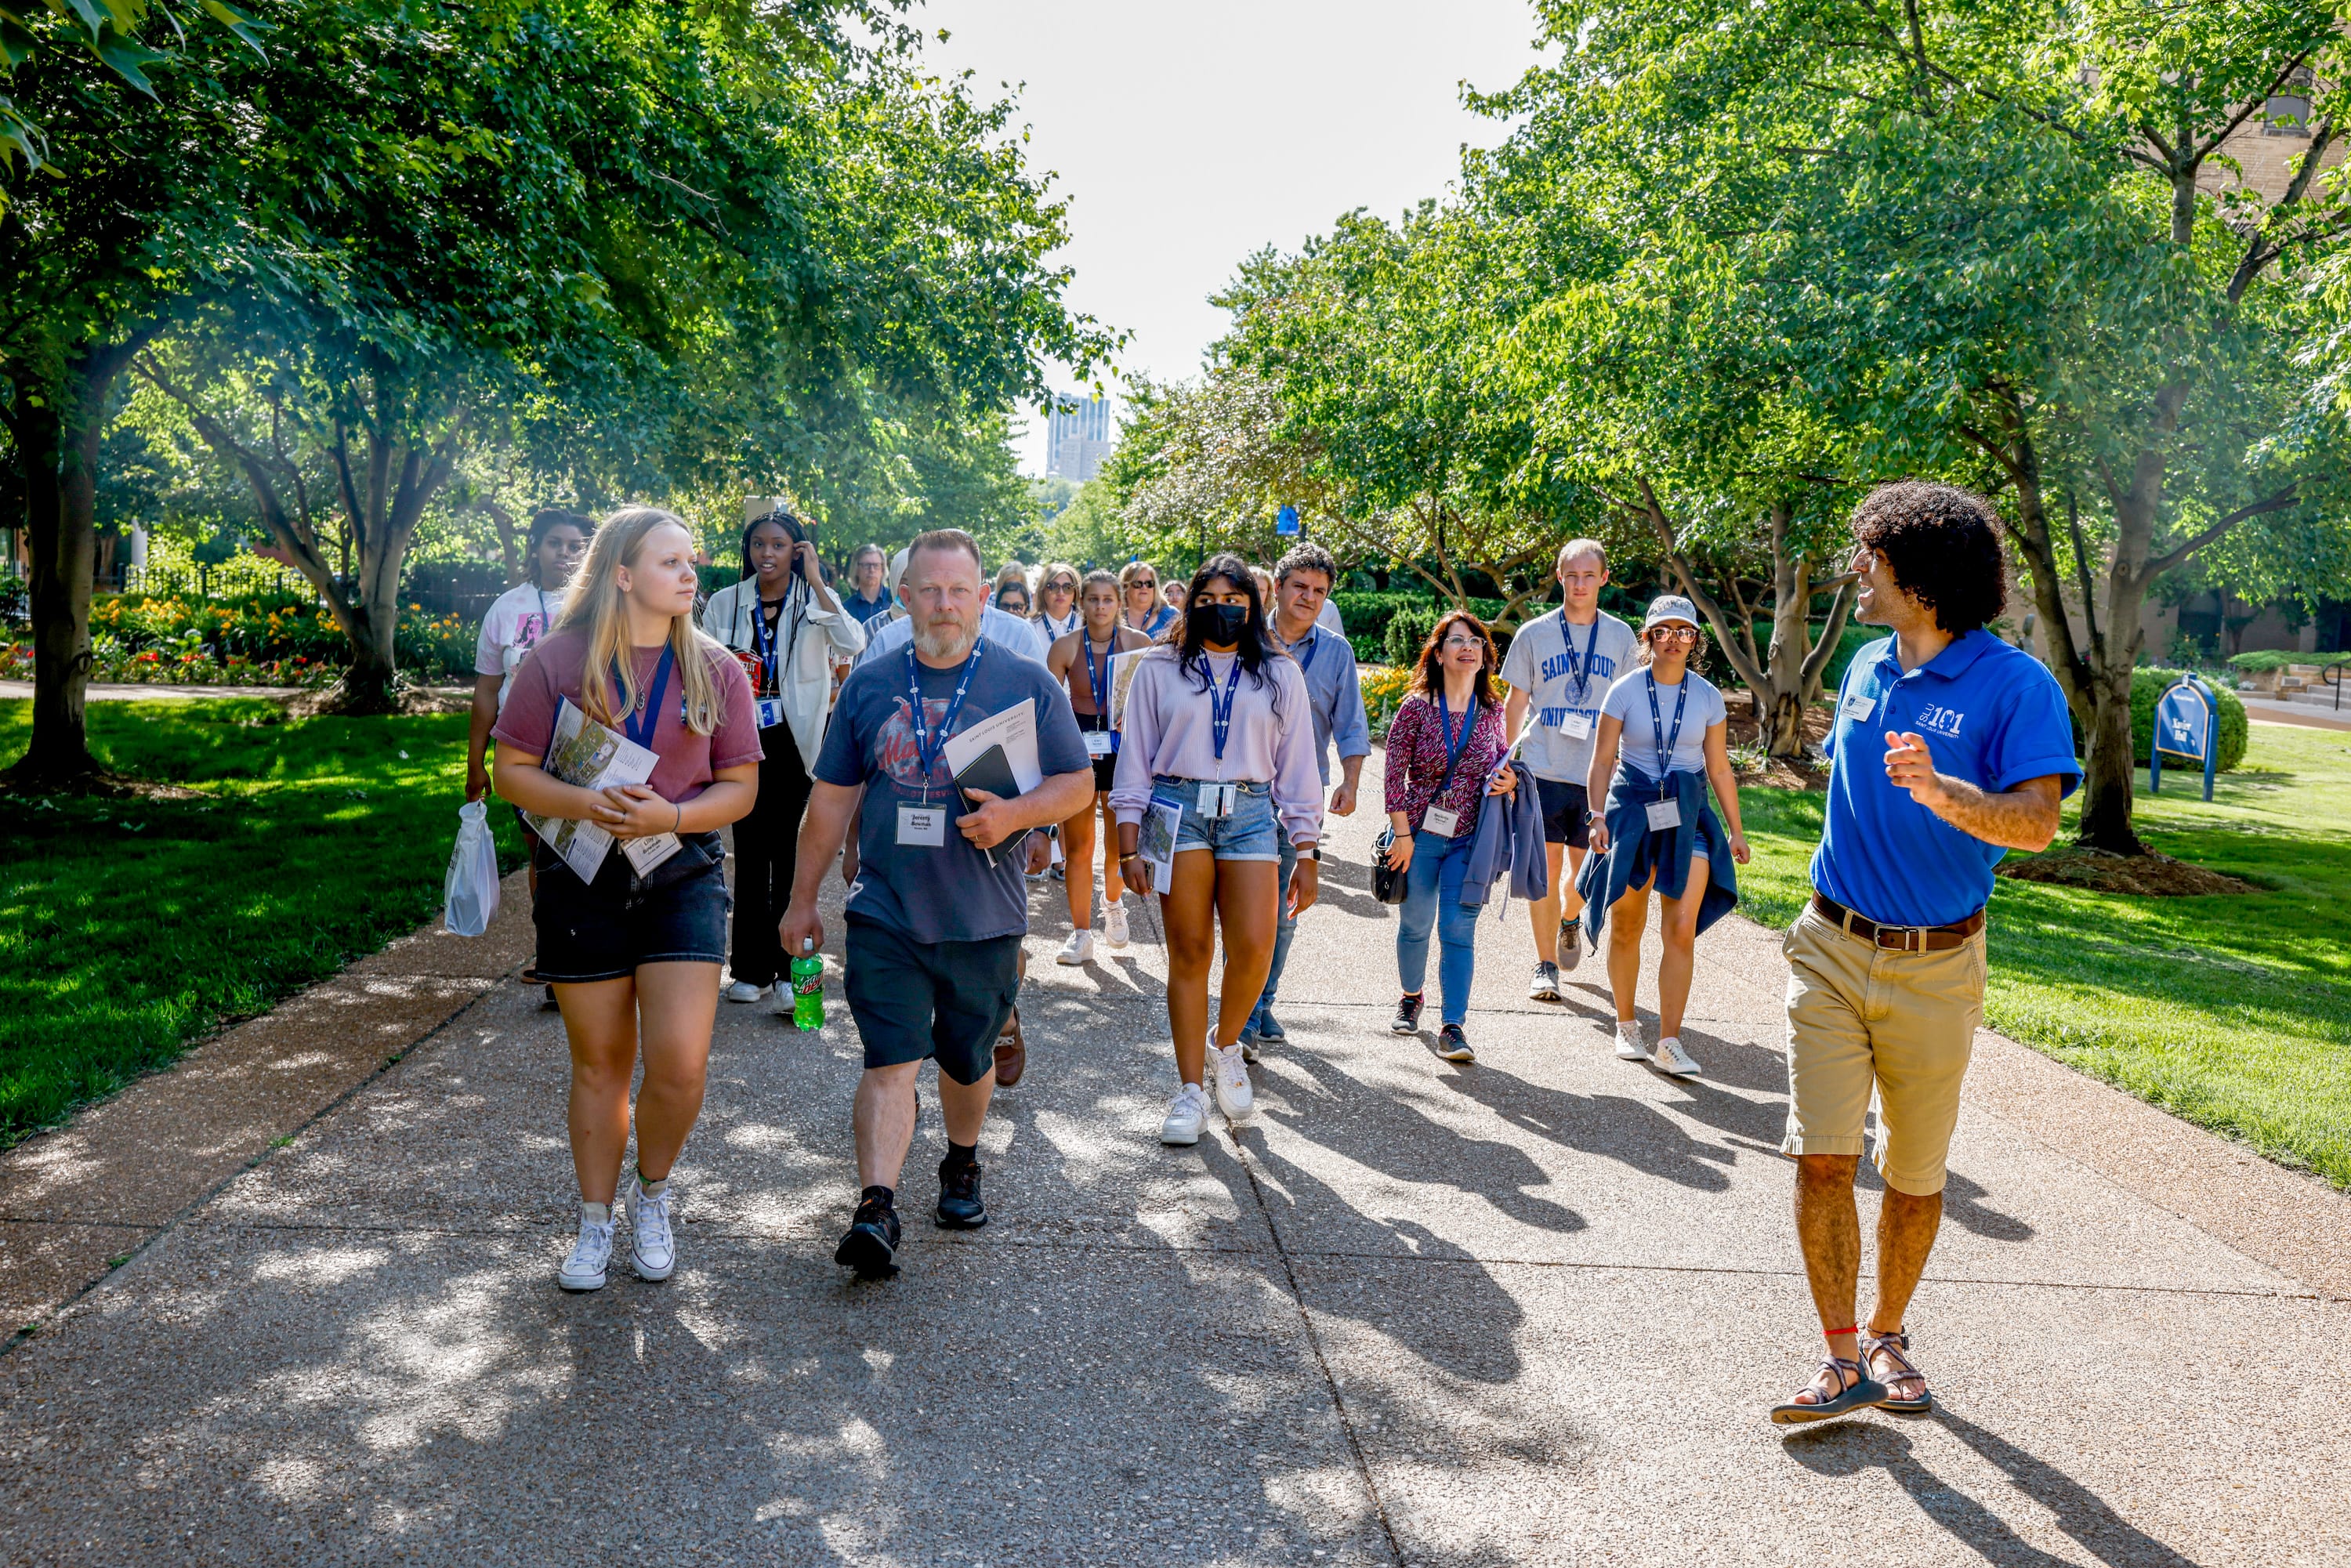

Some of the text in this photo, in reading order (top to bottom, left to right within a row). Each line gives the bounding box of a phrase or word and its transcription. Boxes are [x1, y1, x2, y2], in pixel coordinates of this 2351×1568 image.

[1919, 703, 1935, 722] SLU
[1928, 707, 1965, 735] 101
[969, 733, 982, 743] SAINT
[982, 726, 996, 736] LOUIS
[996, 712, 1023, 727] UNIVERSITY
